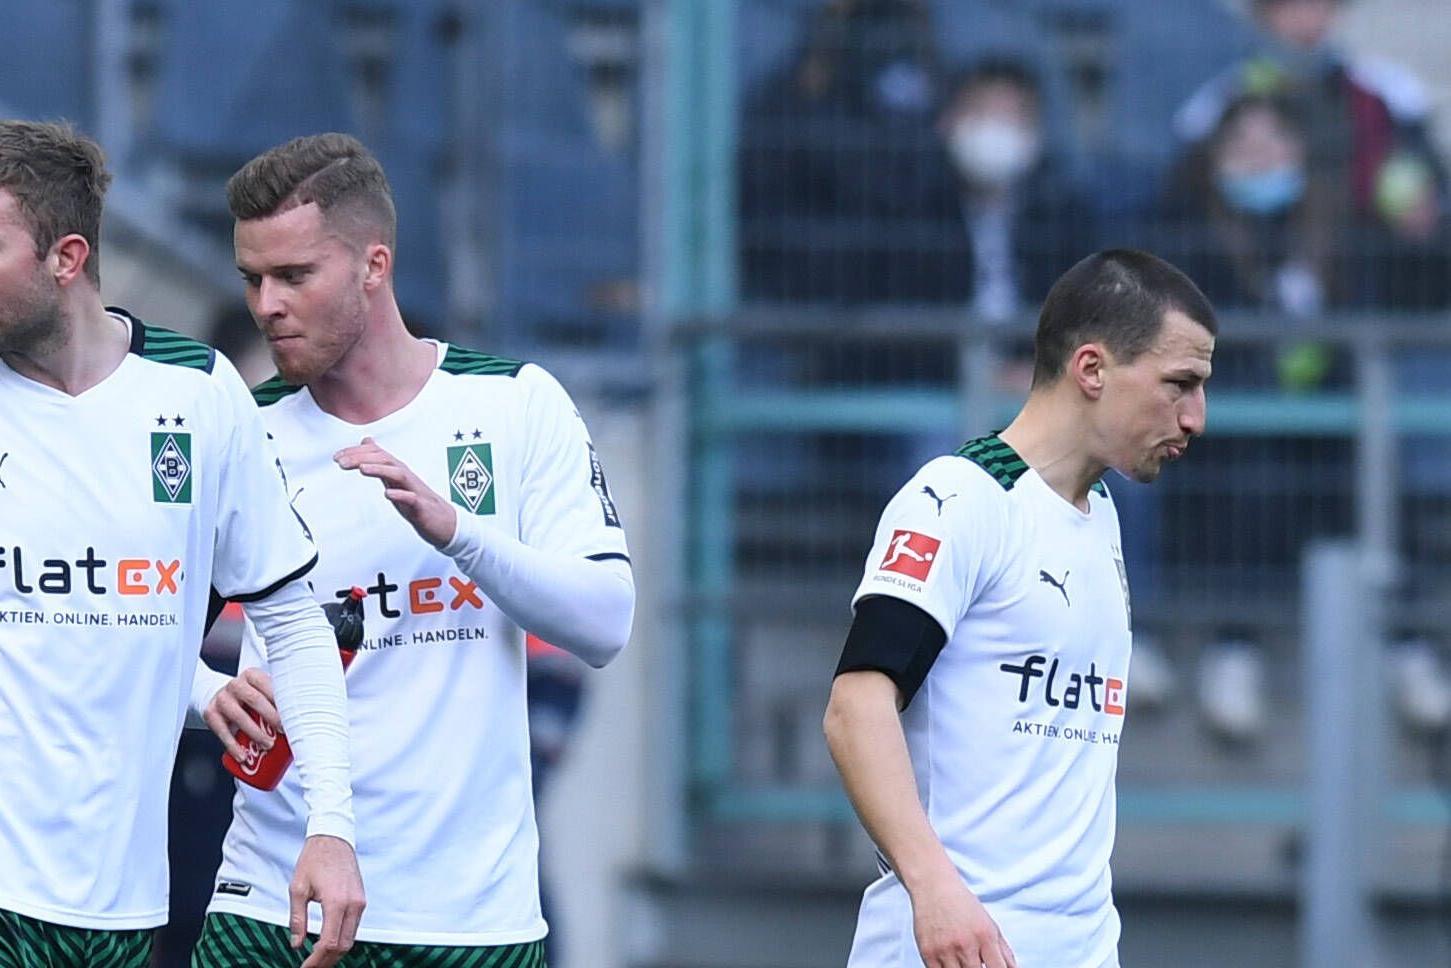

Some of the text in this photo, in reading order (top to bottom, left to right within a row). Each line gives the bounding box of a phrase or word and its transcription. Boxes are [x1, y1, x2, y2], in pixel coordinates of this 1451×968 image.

[53, 612, 113, 626] ONLINE.
[117, 613, 179, 627] HANDELN.
[359, 627, 489, 651] NLINE. HANDELN.
